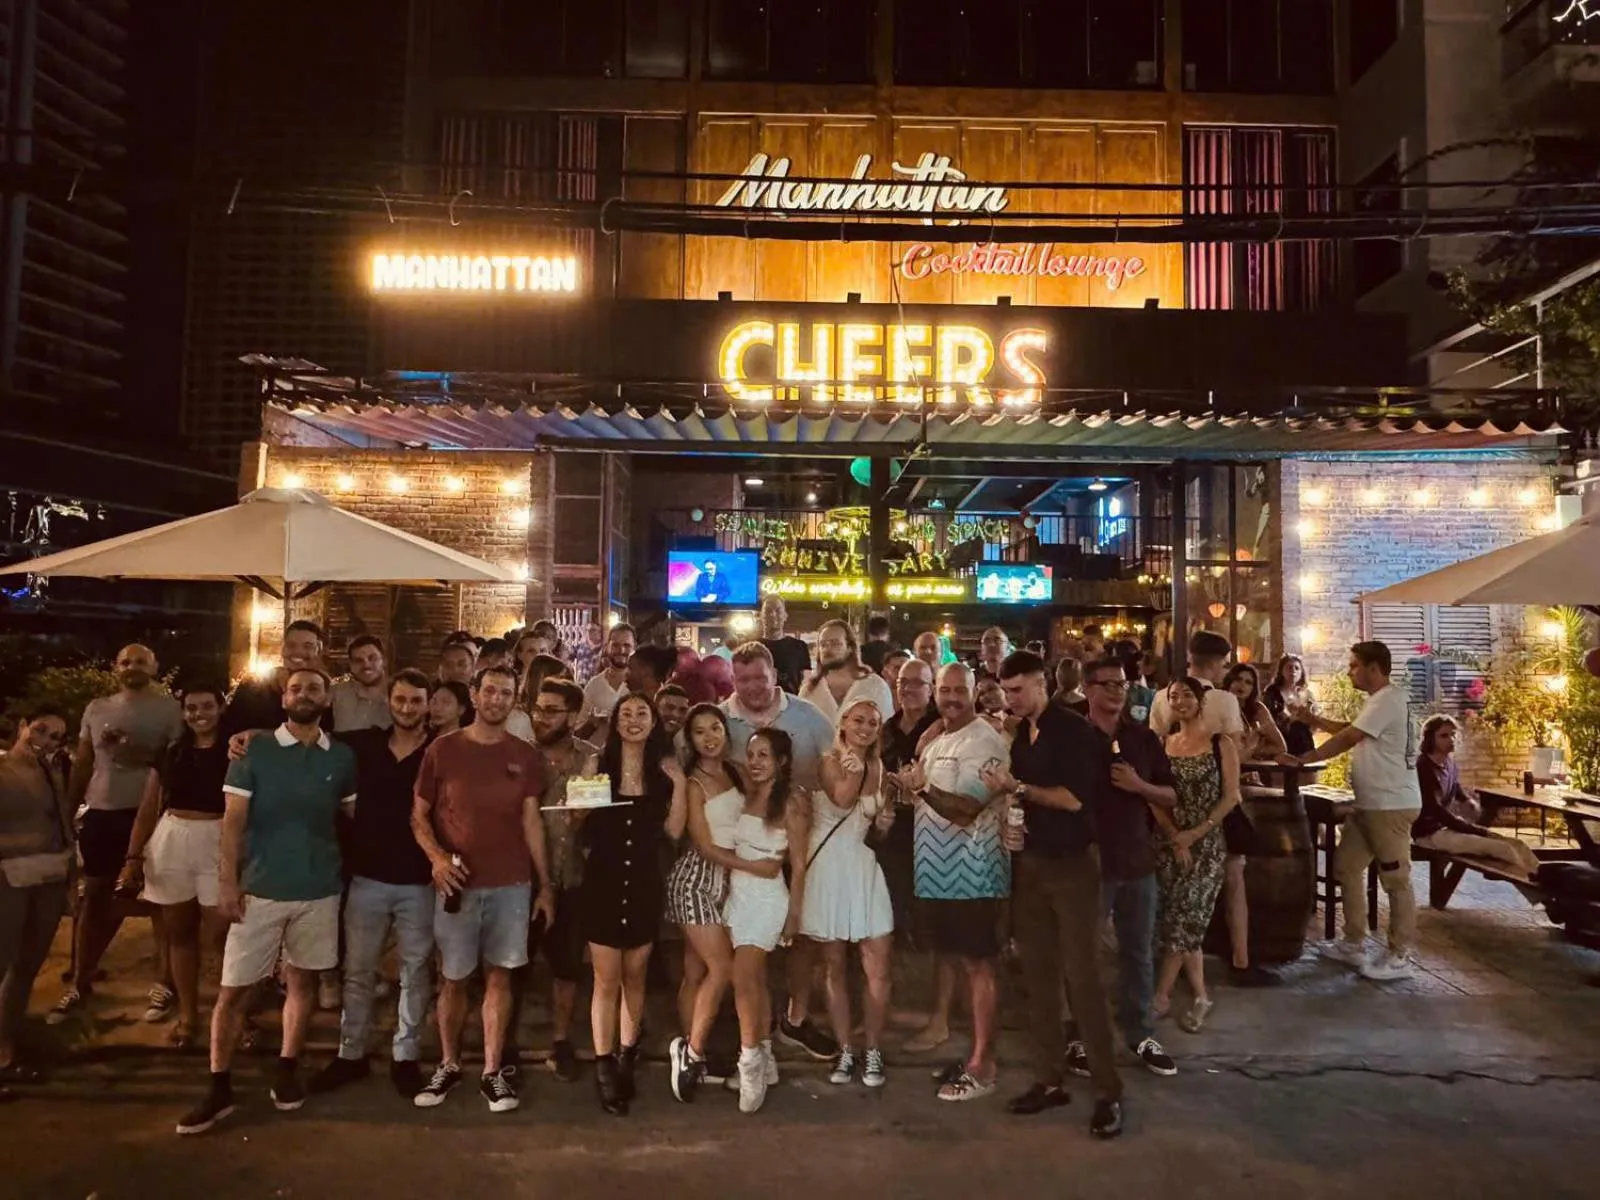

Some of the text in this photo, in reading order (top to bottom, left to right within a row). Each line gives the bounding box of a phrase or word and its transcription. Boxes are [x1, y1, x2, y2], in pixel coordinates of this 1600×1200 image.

[717, 152, 1010, 226] Manhattan
[372, 254, 577, 292] MANHATTAN
[901, 242, 1146, 290] Cocktail lounge
[718, 321, 1047, 403] CHEERS
